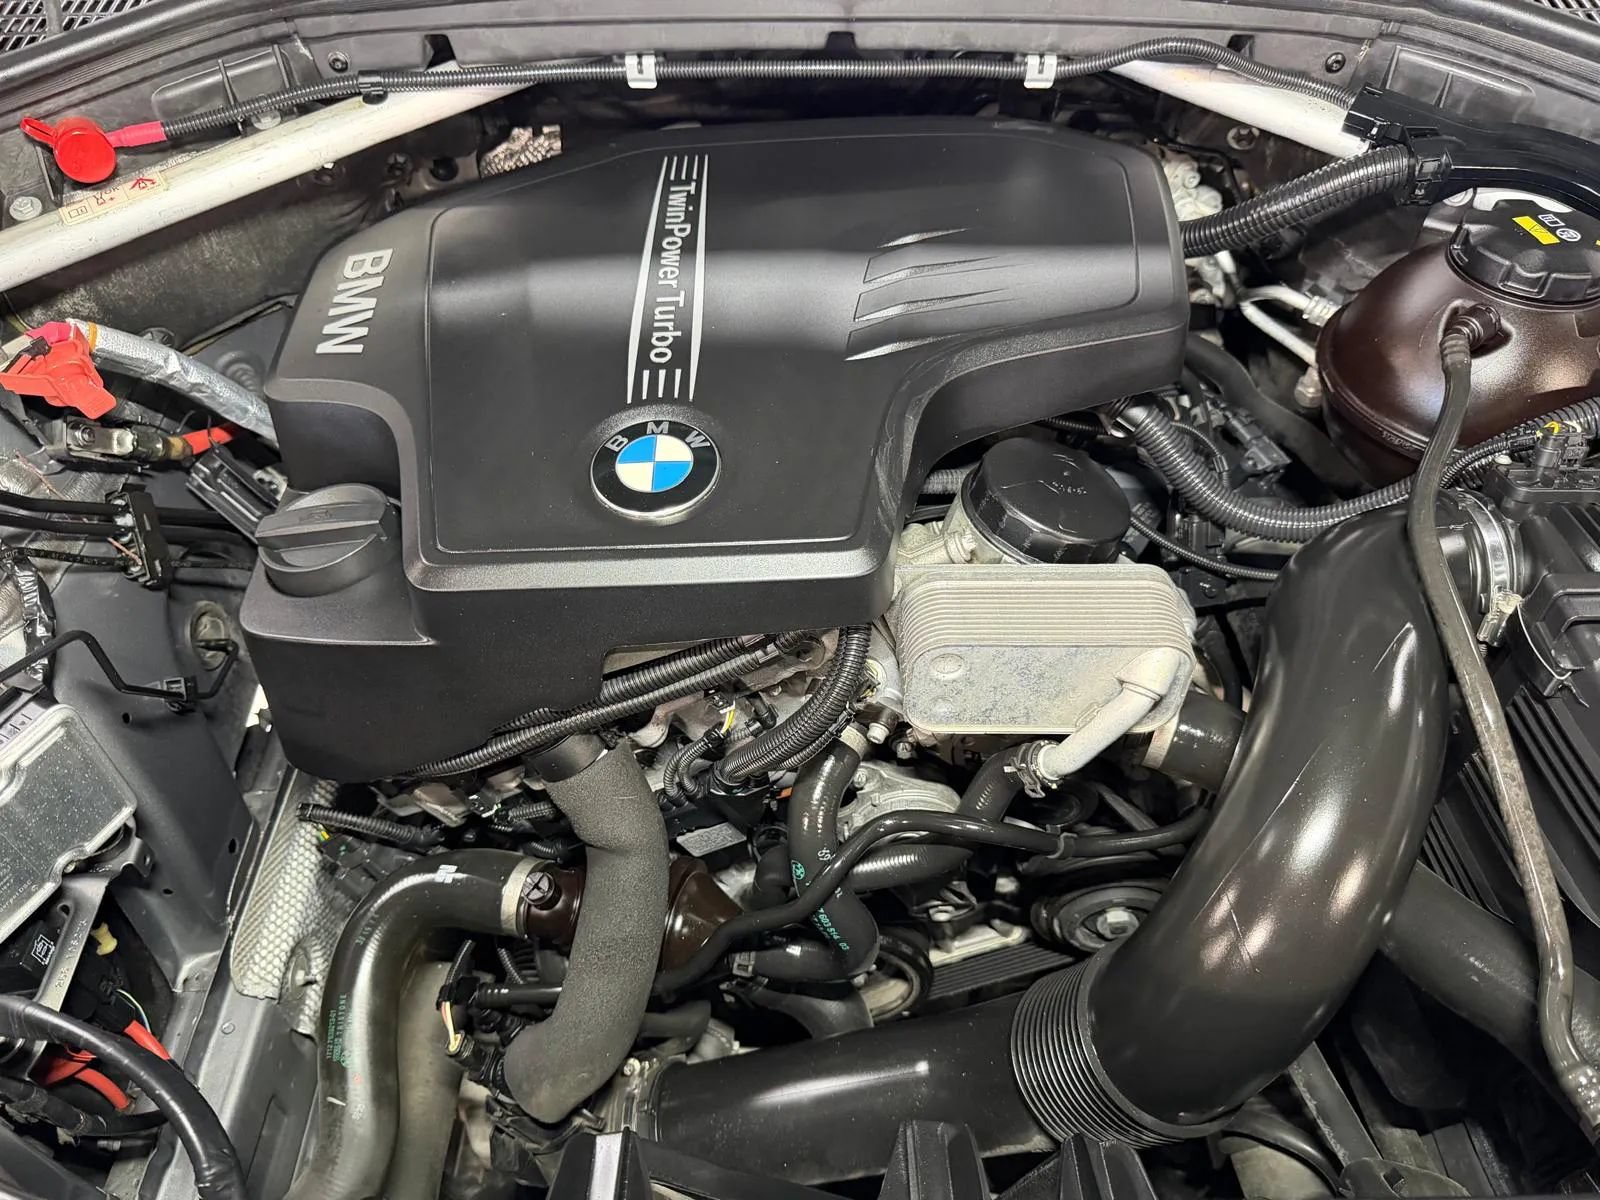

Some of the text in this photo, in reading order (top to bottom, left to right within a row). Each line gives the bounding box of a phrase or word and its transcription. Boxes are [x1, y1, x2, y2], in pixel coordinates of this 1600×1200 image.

[315, 247, 394, 355] BMW
[649, 181, 697, 364] TwinPower Turbo
[604, 420, 712, 453] BMW
